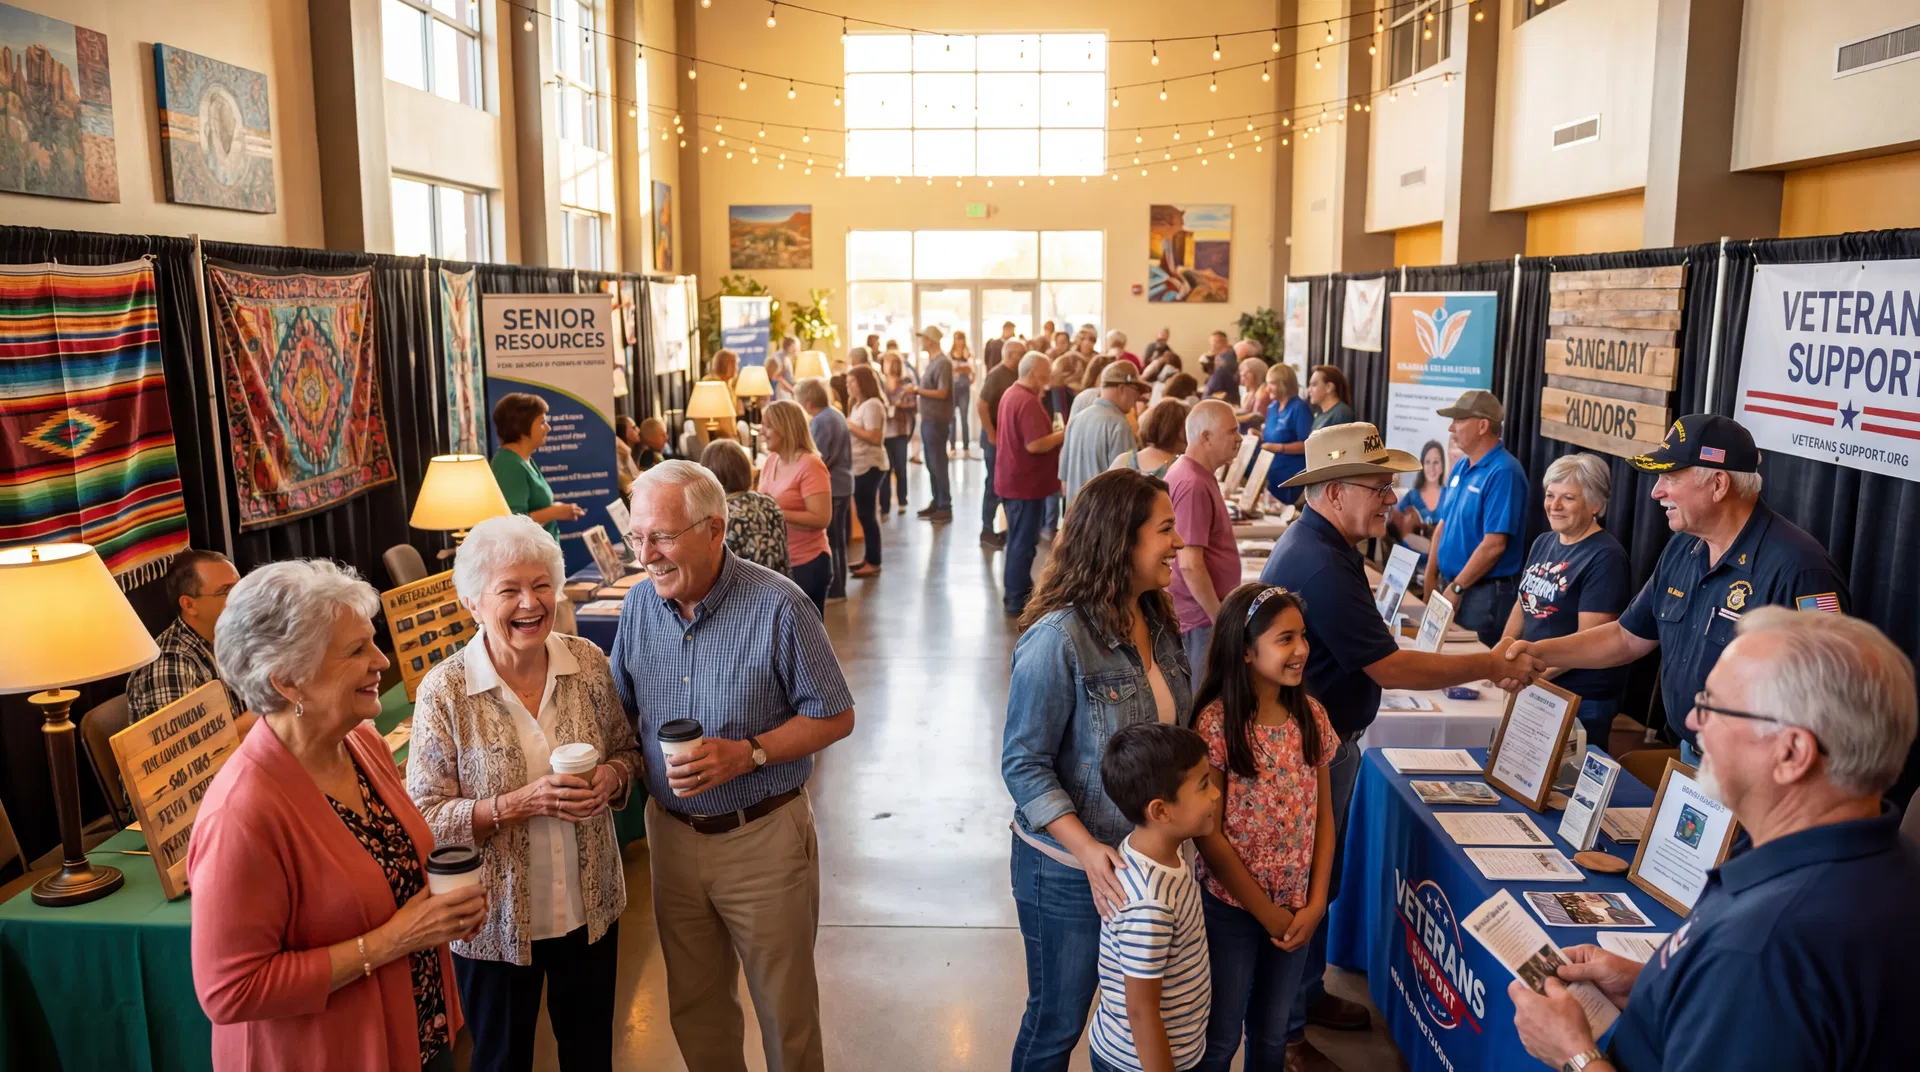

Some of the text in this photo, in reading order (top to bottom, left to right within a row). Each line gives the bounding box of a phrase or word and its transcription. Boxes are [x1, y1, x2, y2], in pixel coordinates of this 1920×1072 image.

[503, 308, 595, 330] SENIOR
[1783, 290, 1920, 336] VETERAN
[495, 332, 605, 351] RESOURCES
[1565, 336, 1649, 375] SANGADAY
[1791, 433, 1909, 467] VETERANS SUPPORT.ORG
[1395, 868, 1486, 1019] VETERANS
[1412, 939, 1456, 1010] SUPPORT
